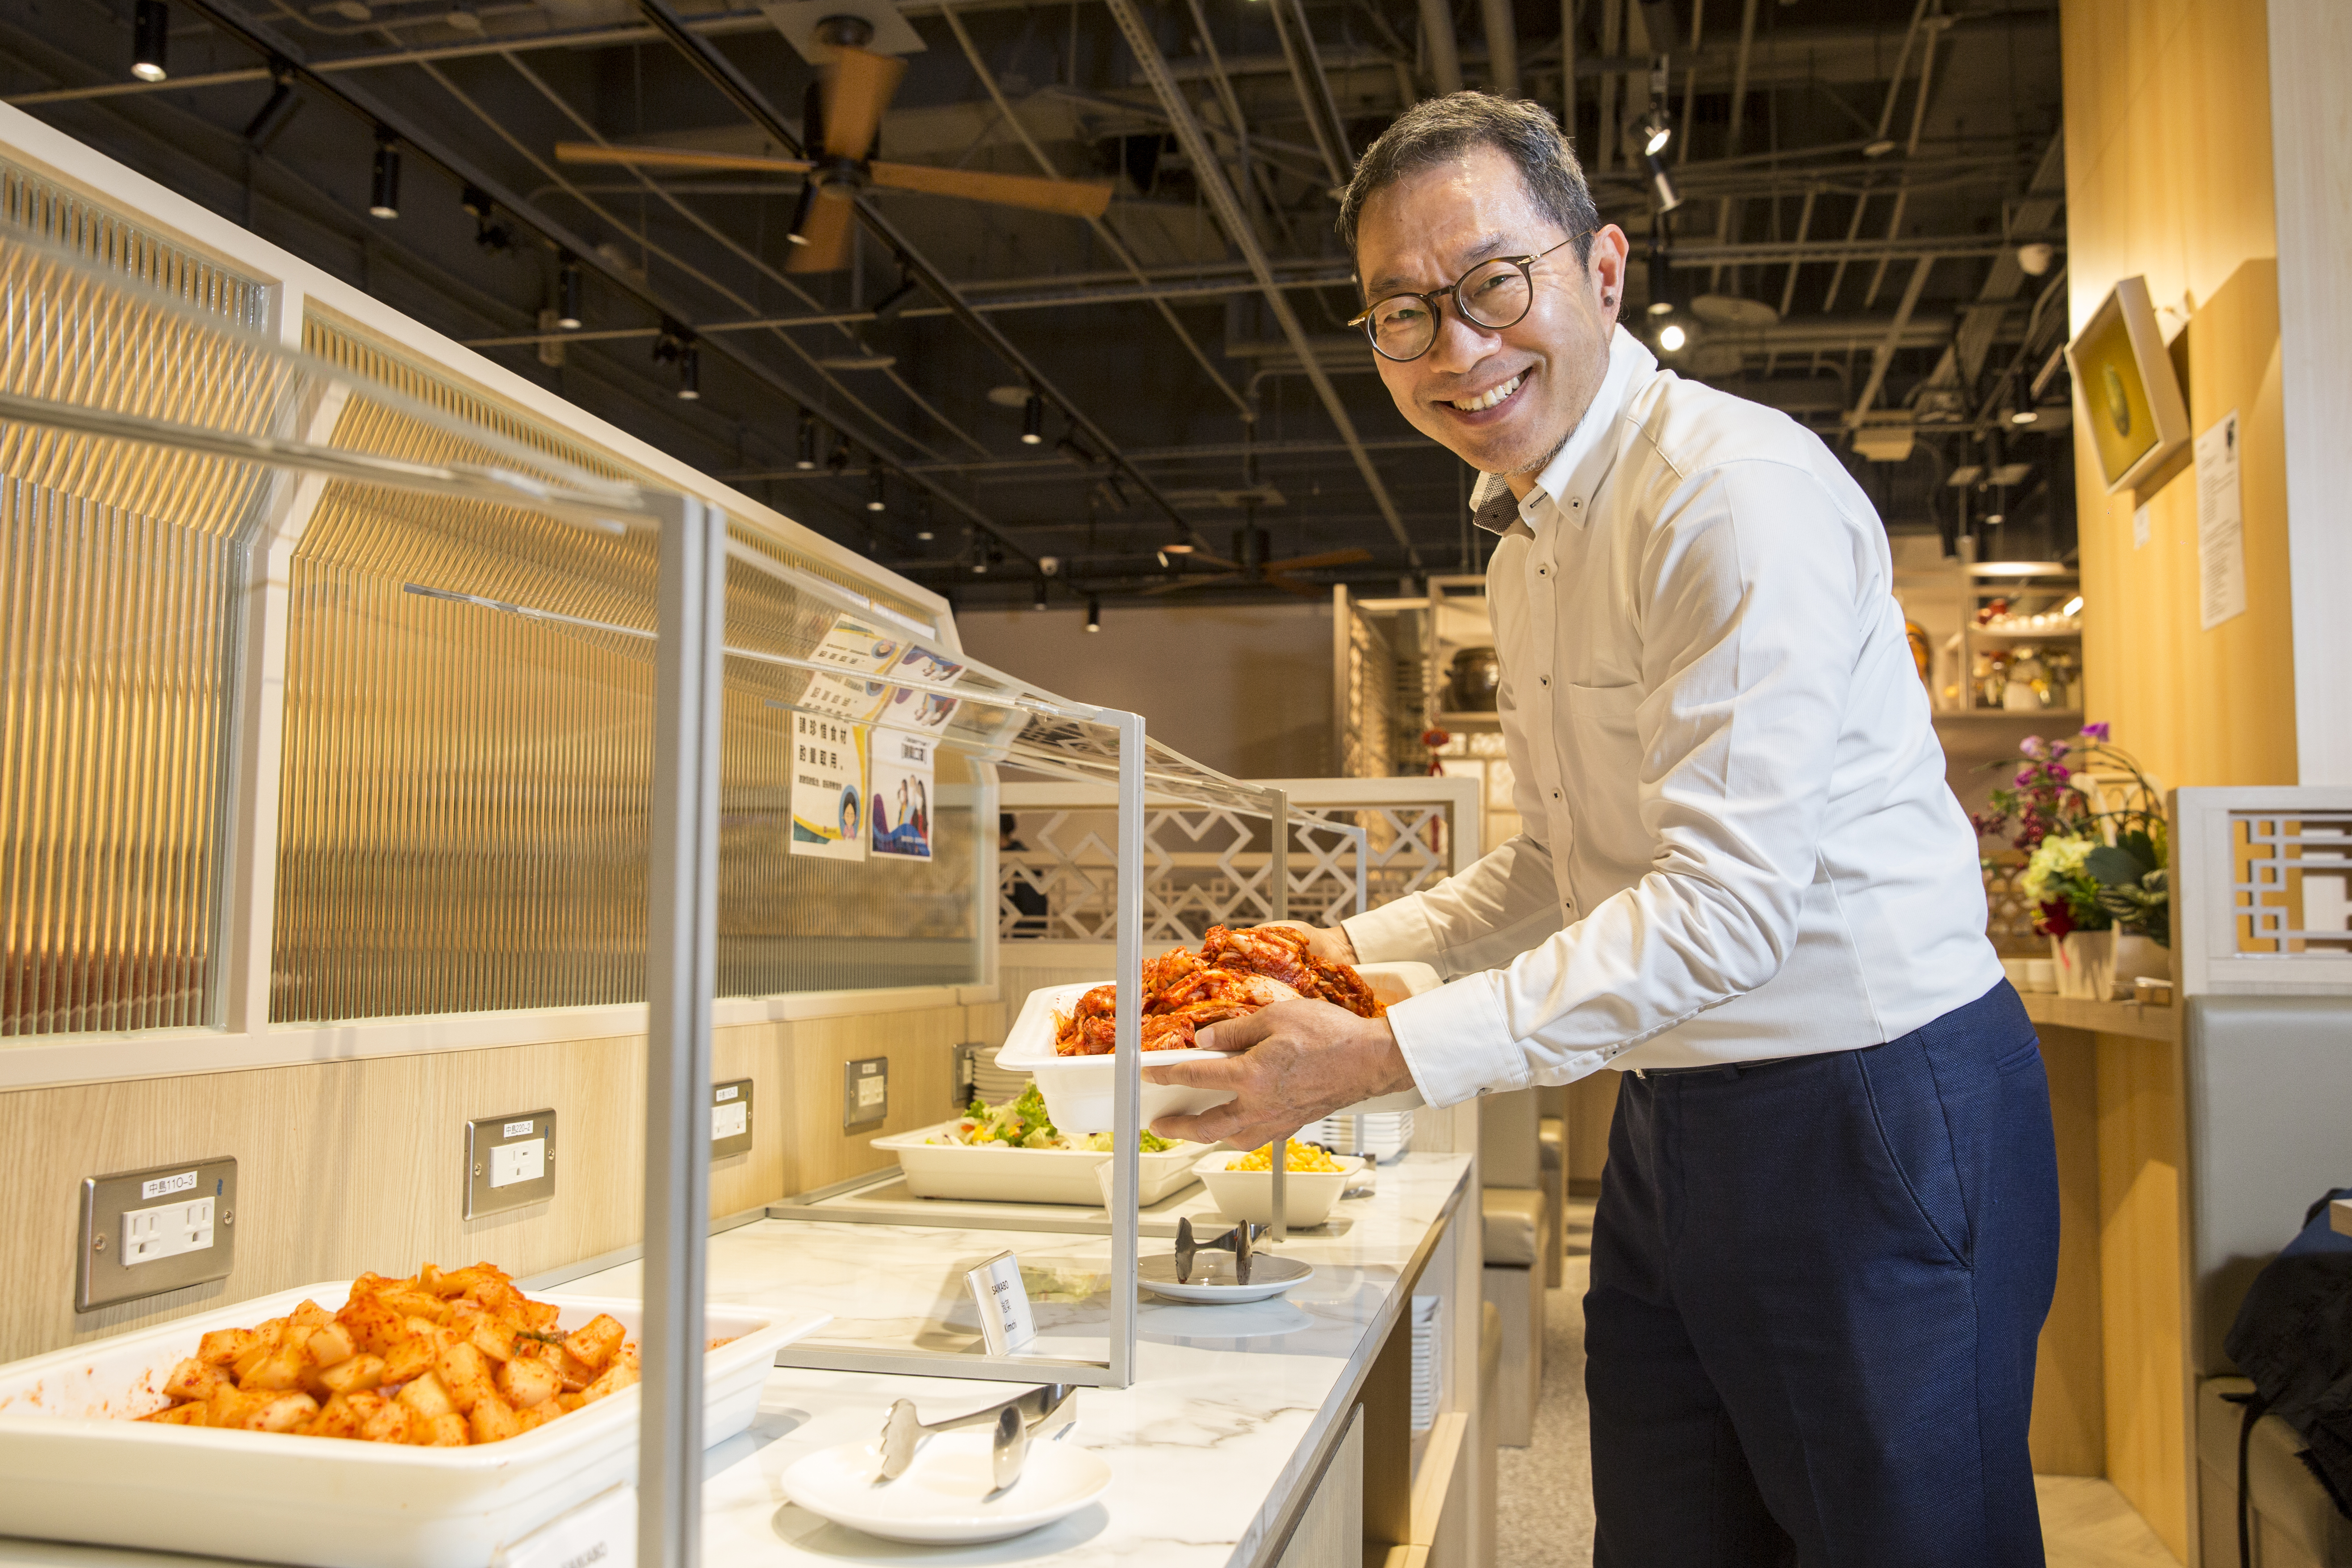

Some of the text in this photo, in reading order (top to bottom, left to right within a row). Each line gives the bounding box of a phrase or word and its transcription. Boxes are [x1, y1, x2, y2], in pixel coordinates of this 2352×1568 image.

[506, 1123, 531, 1135] 中島220-2
[149, 1175, 193, 1194] 中島110-3
[992, 1280, 1009, 1295] SAIKABO
[1000, 1299, 1012, 1314] 泡菜
[1004, 1319, 1017, 1334] Kimchi
